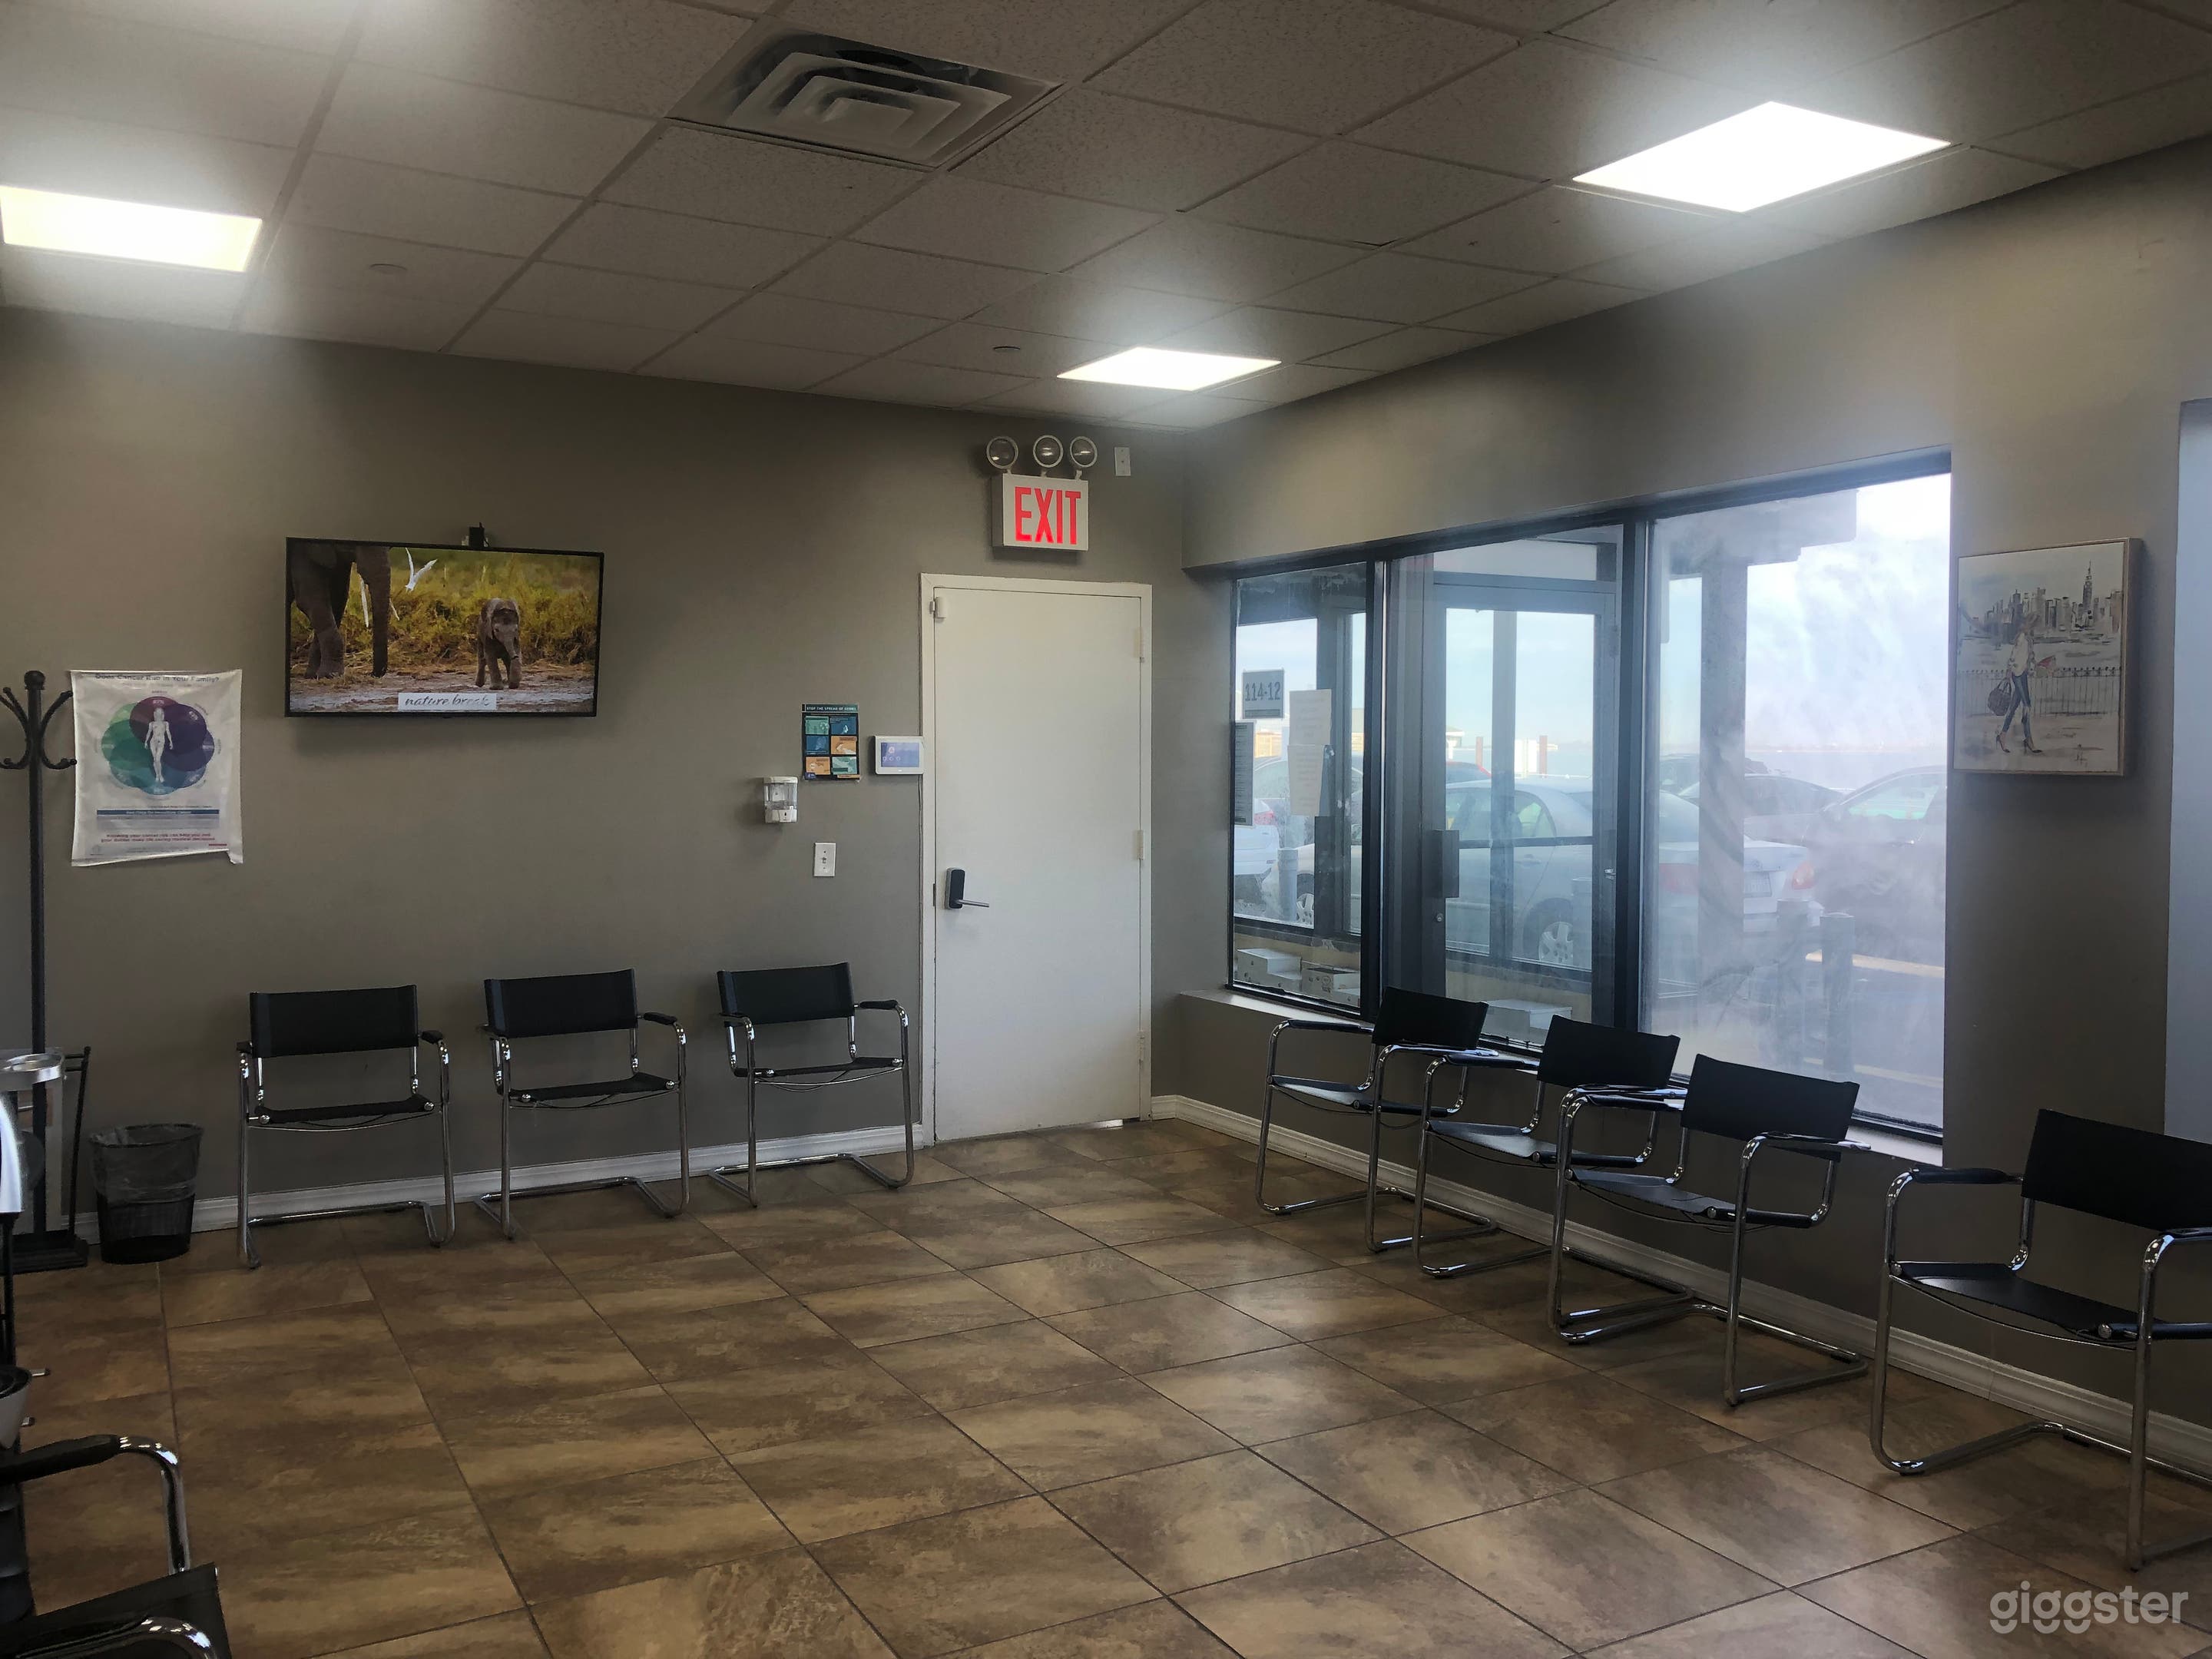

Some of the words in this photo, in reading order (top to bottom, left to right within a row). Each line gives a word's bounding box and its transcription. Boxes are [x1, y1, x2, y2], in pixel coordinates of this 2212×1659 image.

[1015, 486, 1081, 545] EXIT
[405, 695, 449, 707] nature
[1244, 681, 1281, 701] 114-12
